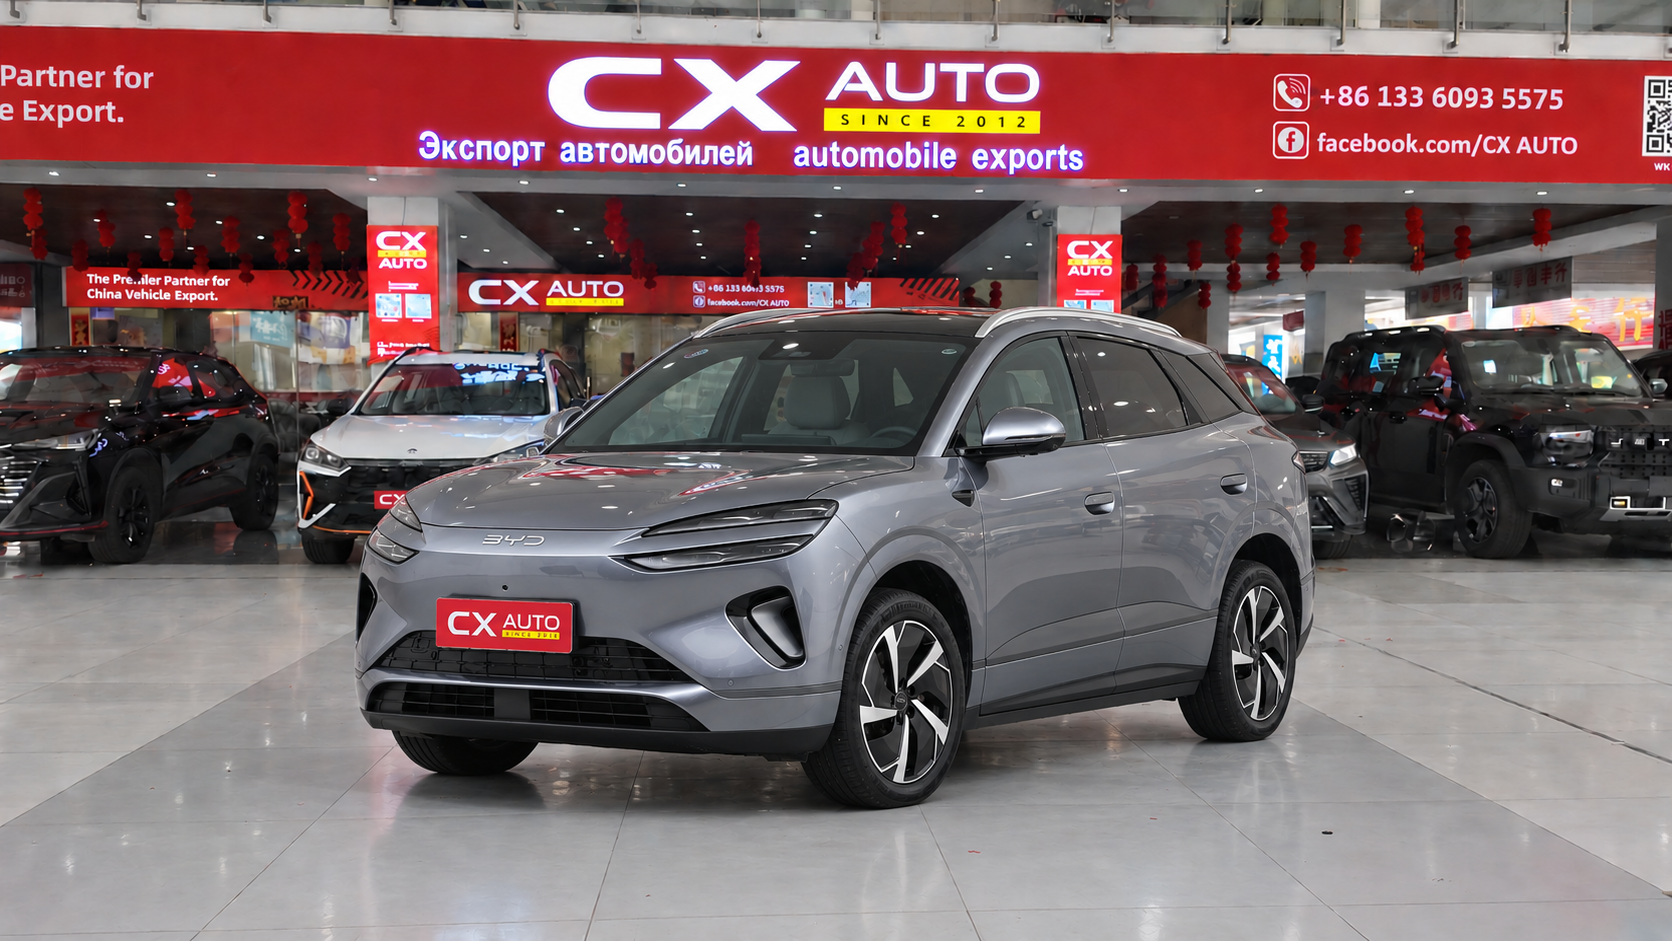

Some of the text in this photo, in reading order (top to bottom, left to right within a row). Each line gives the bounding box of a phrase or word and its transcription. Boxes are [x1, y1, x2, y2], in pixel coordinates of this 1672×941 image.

[0, 65, 154, 89] Partner for
[547, 56, 1040, 132] CX AUTO
[1320, 85, 1563, 110] +86 133 6093 5575
[23, 100, 124, 128] Export.
[840, 113, 1026, 128] SINCE 2012
[418, 130, 753, 167] Экспорт автомобилей
[1317, 132, 1578, 158] facebook.com/CX AUTO
[793, 141, 1084, 175] automobile exports
[376, 230, 427, 250] CX
[1066, 240, 1114, 259] CX
[378, 257, 427, 270] AUTO
[1067, 265, 1113, 276] AUTO
[86, 273, 231, 287] The Preier Partner for
[87, 288, 218, 303] China Vehicle Export.
[468, 279, 624, 306] CX AUTO
[482, 534, 546, 546] BYD
[447, 610, 560, 637] CX AUTO
